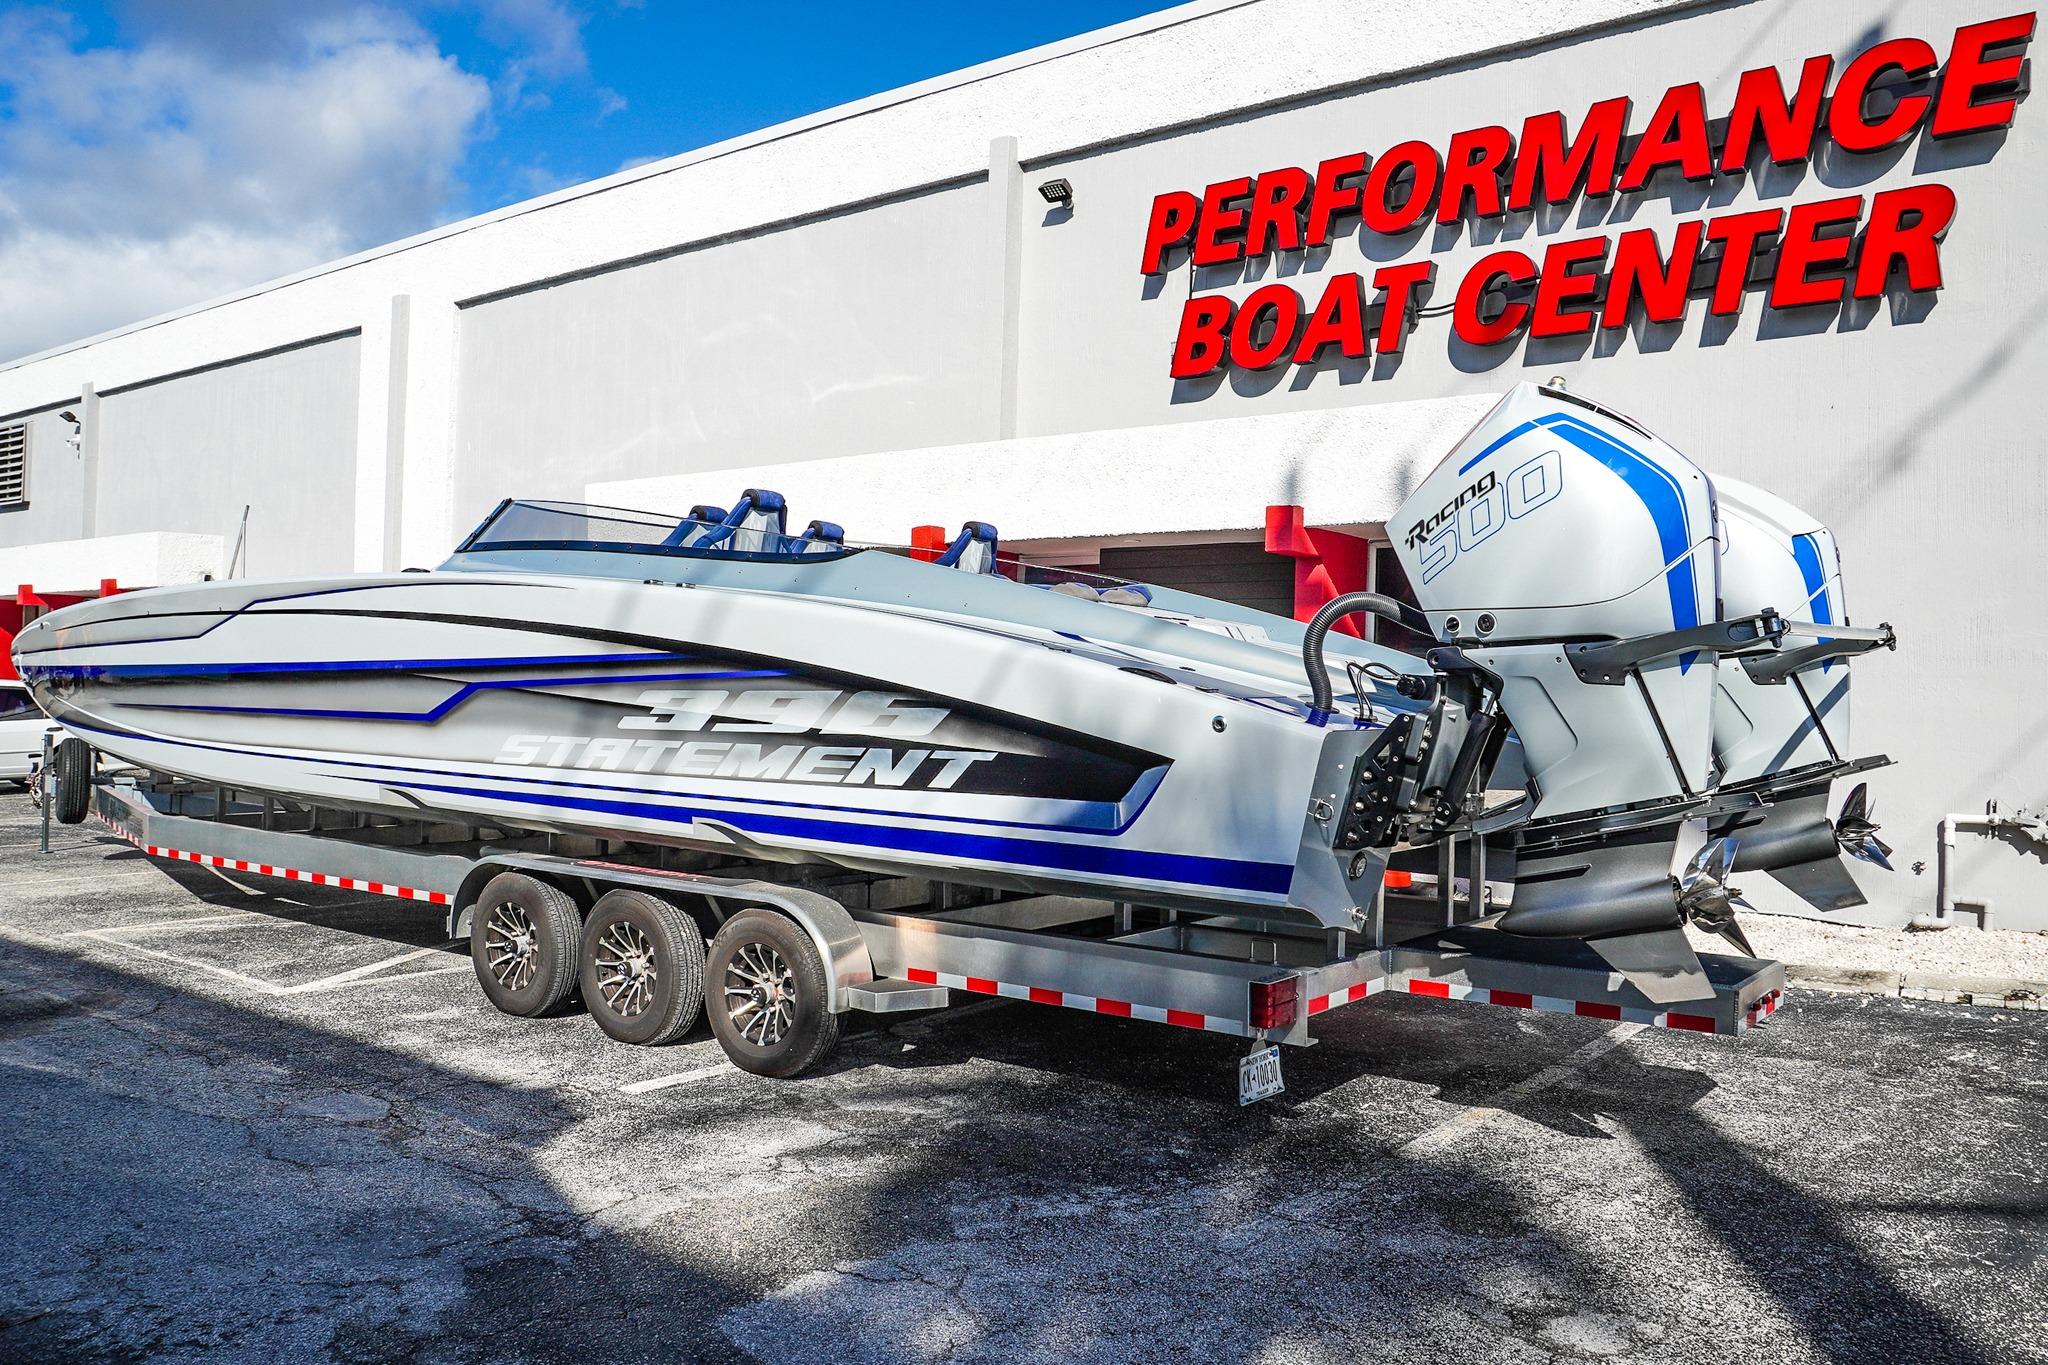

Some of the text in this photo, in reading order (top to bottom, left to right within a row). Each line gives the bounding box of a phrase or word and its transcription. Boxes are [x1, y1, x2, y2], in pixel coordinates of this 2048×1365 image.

[1140, 11, 2036, 276] PERFORMANCE
[1170, 184, 1957, 380] BOAT CENTER
[1405, 471, 1496, 551] Racing
[1419, 450, 1563, 585] 500
[493, 734, 999, 789] STATEMENT
[617, 689, 951, 737] 396
